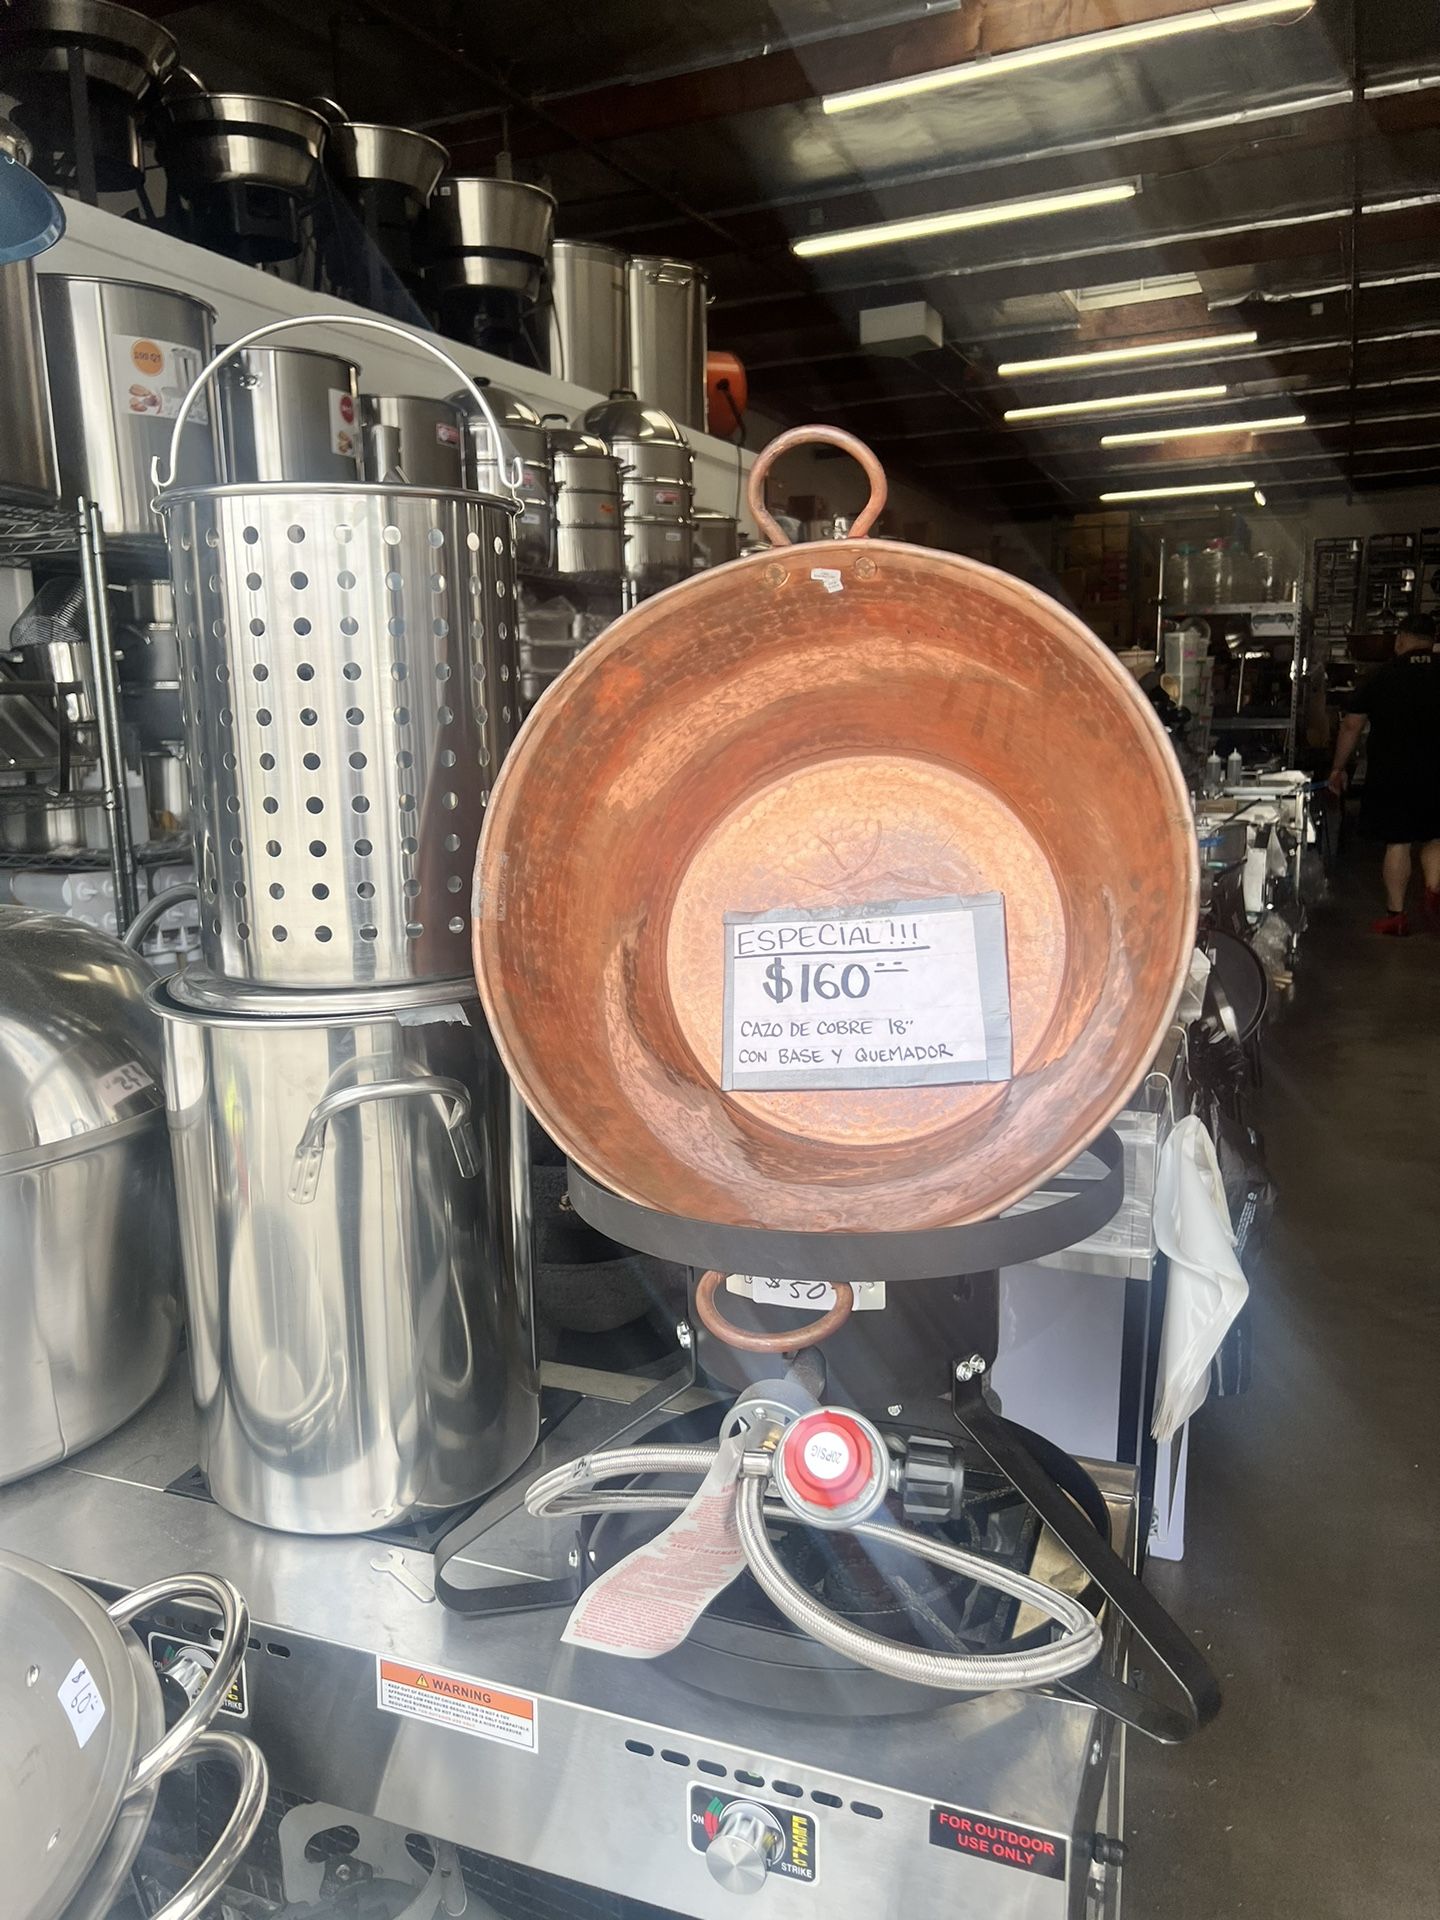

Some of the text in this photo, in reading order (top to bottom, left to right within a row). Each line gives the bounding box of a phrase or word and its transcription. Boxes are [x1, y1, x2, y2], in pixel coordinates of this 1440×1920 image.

[740, 1021, 783, 1037] CAZO
[790, 1021, 810, 1037] DE
[816, 1020, 873, 1035] COBRE
[738, 1043, 953, 1064] CON BASE Y QUEMADOR
[432, 1678, 492, 1704] WARNING
[691, 1813, 705, 1825] ON
[939, 1812, 1055, 1856] FOR OUTDOOR
[957, 1833, 1035, 1865] USE ONLY
[781, 1862, 813, 1879] STRIKE
